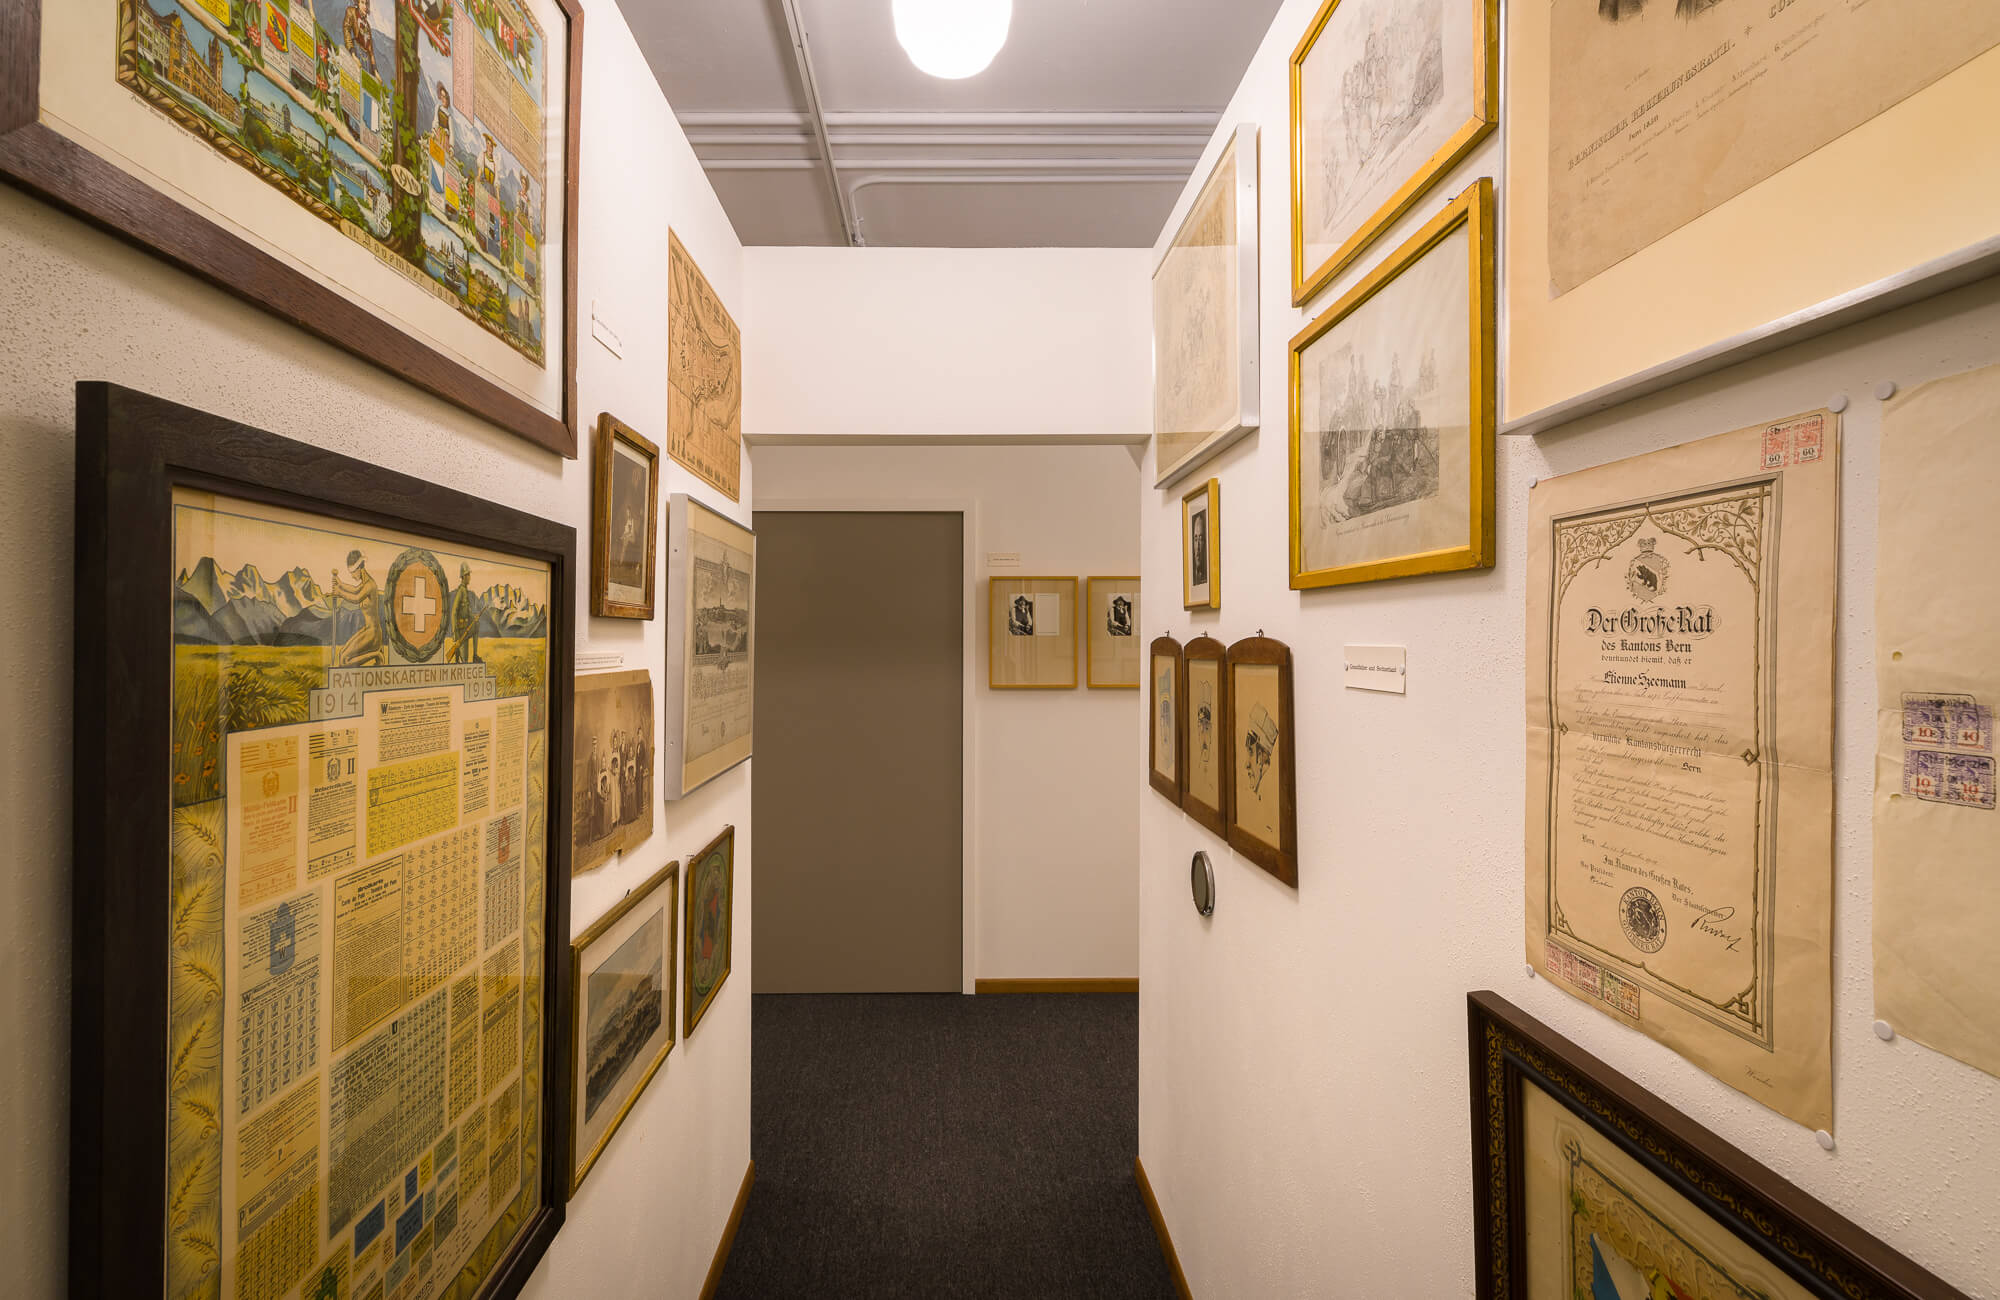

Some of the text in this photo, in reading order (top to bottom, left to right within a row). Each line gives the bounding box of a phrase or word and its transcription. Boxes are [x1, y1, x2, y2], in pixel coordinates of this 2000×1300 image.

[1585, 607, 1618, 633] Der
[1675, 606, 1713, 633] Rat
[1601, 639, 1692, 653] des Kantons Bern
[333, 666, 484, 689] RATIONSKARTEN IM KRIEGE
[468, 681, 493, 698] 1919
[316, 691, 359, 715] 1914
